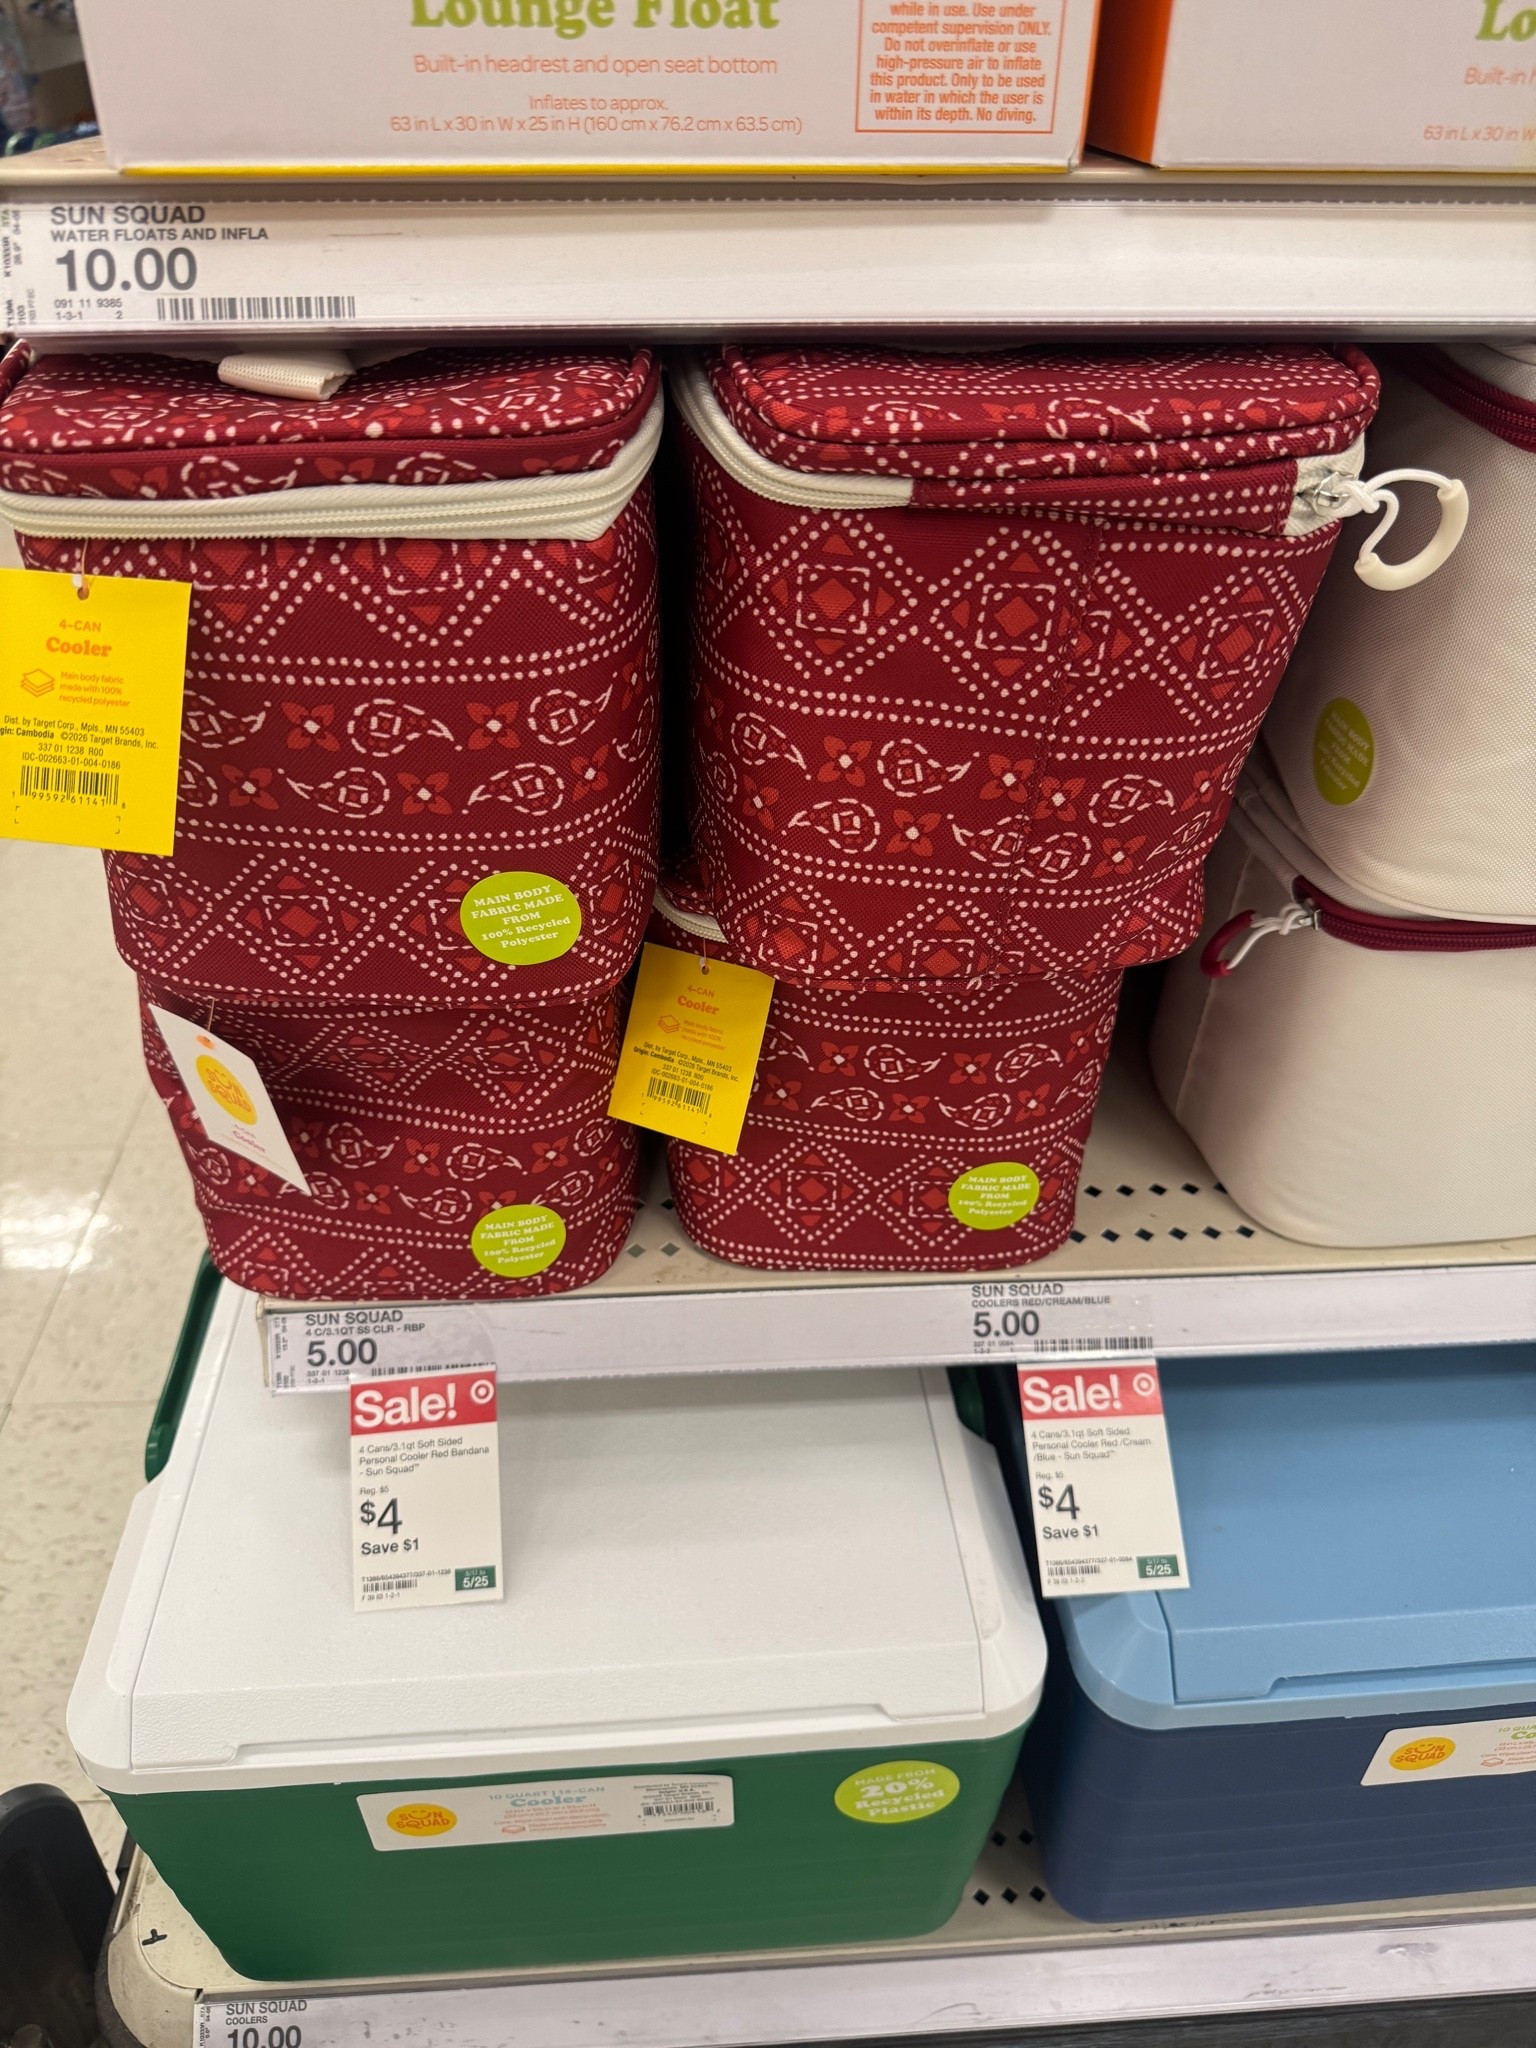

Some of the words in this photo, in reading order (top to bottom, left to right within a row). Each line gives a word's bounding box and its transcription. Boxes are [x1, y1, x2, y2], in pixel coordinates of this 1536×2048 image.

[890, 3, 924, 16] while
[928, 4, 940, 16] in
[944, 6, 968, 16] use.
[973, 4, 995, 17] Use
[999, 4, 1036, 18] under
[411, 0, 614, 40] Lounge
[633, 0, 779, 28] Float
[872, 21, 938, 38] competent
[942, 22, 1014, 38] supervision
[1018, 22, 1051, 36] ONLY.
[885, 38, 900, 51] Do
[905, 39, 925, 52] not
[928, 38, 994, 53] overinflate
[998, 42, 1011, 53] or
[1015, 42, 1036, 53] use
[414, 55, 482, 73] Built-in
[486, 55, 570, 73] headrest
[574, 56, 608, 73] and
[613, 58, 660, 76] open
[665, 57, 704, 74] seat
[709, 56, 777, 74] bottom
[877, 55, 964, 72] high-pressure
[967, 56, 983, 69] air
[987, 57, 998, 70] to
[1003, 56, 1041, 70] inflate
[870, 73, 893, 86] this
[896, 74, 947, 89] product.
[952, 74, 977, 89] Only
[982, 75, 994, 86] to
[998, 74, 1012, 87] be
[1016, 74, 1045, 88] used
[530, 96, 586, 110] Inflates
[591, 97, 607, 110] to
[610, 98, 667, 113] approx.
[870, 91, 881, 103] in
[885, 91, 920, 103] water
[924, 91, 935, 103] in
[939, 91, 976, 104] which
[980, 91, 998, 104] the
[1002, 94, 1029, 104] user
[1033, 92, 1043, 105] is
[875, 108, 912, 120] within
[917, 108, 931, 121] its
[935, 108, 973, 123] depth.
[976, 109, 992, 121] No
[996, 109, 1036, 124] diving.
[50, 207, 105, 225] SUN
[113, 206, 205, 225] SQUAD
[52, 229, 109, 242] WATER
[114, 229, 177, 241] FLOATS
[182, 228, 216, 240] AND
[221, 227, 268, 240] INFLA
[56, 247, 197, 292] 10.00
[55, 299, 72, 309] 091
[80, 299, 91, 308] 11
[97, 298, 122, 308] 9385
[56, 311, 83, 321] 1-3-1
[116, 310, 123, 320] 2
[59, 619, 101, 633] 4-CAN
[46, 637, 112, 657] Cooler
[61, 671, 78, 681] Main
[80, 673, 100, 684] body
[101, 674, 125, 685] fabric
[60, 683, 78, 692] made
[80, 684, 99, 693] with
[101, 685, 122, 695] 100%
[59, 694, 92, 705] recycled
[94, 697, 130, 708] polyester
[4, 715, 20, 726] Dist.
[22, 717, 31, 727] by
[33, 717, 56, 729] Target
[58, 720, 78, 732] Corp.,
[81, 723, 103, 733] Mpls.,
[106, 724, 118, 734] MN
[120, 725, 145, 736] 55403
[16, 727, 54, 740] Cambodia
[61, 732, 88, 742] ©2026
[90, 734, 113, 746] Target
[115, 737, 143, 749] Brands,
[145, 740, 159, 749] Inc.
[38, 743, 52, 752] 337
[54, 745, 63, 753] 01
[66, 745, 84, 755] 1238
[88, 747, 104, 757] R00
[474, 894, 510, 907] MAIN
[514, 885, 552, 900] BODY
[471, 903, 521, 919] FABRIC
[524, 894, 564, 910] MADE
[502, 911, 541, 925] FROM
[481, 928, 513, 941] 100%
[515, 917, 571, 934] Recycled
[500, 932, 559, 949] Polyester
[687, 985, 715, 998] 4-CAN
[677, 995, 720, 1015] Cooler
[999, 1175, 1027, 1183] BODY
[1002, 1183, 1031, 1191] MADE
[485, 1222, 514, 1230] MAIN
[518, 1215, 547, 1226] BODY
[480, 1229, 521, 1239] FABRIC
[524, 1222, 555, 1234] MADE
[504, 1236, 534, 1246] FROM
[497, 1252, 544, 1263] Polyester
[972, 1285, 1004, 1298] SUN
[1009, 1283, 1063, 1296] SQUAD
[972, 1299, 1019, 1308] COOLERS
[1022, 1296, 1110, 1306] RED/CREAM/BLUE
[305, 1314, 340, 1326] SUN
[345, 1310, 403, 1324] SQUAD
[973, 1310, 1039, 1338] 5.00
[307, 1338, 378, 1367] 5.00
[1023, 1374, 1122, 1414] Sale!
[354, 1383, 457, 1429] Sale!
[367, 1441, 415, 1454] Cans/3.1qt
[418, 1439, 435, 1448] Soft
[438, 1436, 463, 1446] Sided
[1032, 1440, 1069, 1450] Personal
[1071, 1439, 1099, 1448] Cooler
[1101, 1439, 1118, 1447] Red
[1120, 1437, 1151, 1447] /Cream
[360, 1454, 398, 1465] Personal
[400, 1452, 428, 1461] Cooler
[431, 1449, 449, 1458] Red
[451, 1446, 490, 1456] Bandana
[1038, 1483, 1081, 1520] $4
[360, 1497, 403, 1535] $4
[1042, 1526, 1079, 1539] Save
[1083, 1524, 1099, 1537] $1
[361, 1540, 399, 1556] Save
[404, 1538, 420, 1551] $1
[1145, 1564, 1172, 1576] 5/25
[463, 1576, 489, 1588] 5/25
[1404, 1743, 1445, 1755] SUN
[1396, 1751, 1446, 1763] SQUAD
[855, 1775, 893, 1786] MADE
[897, 1768, 936, 1779] FROM
[860, 1777, 935, 1798] 20%
[511, 1796, 587, 1807] Cooler
[856, 1789, 945, 1809] Recycled
[399, 1809, 443, 1822] SUN
[868, 1801, 935, 1816] Plastic
[395, 1818, 451, 1829] SQUAD
[226, 2003, 255, 2015] SUN
[259, 2000, 307, 2014] SQUAD
[225, 2016, 268, 2025] COOLERS
